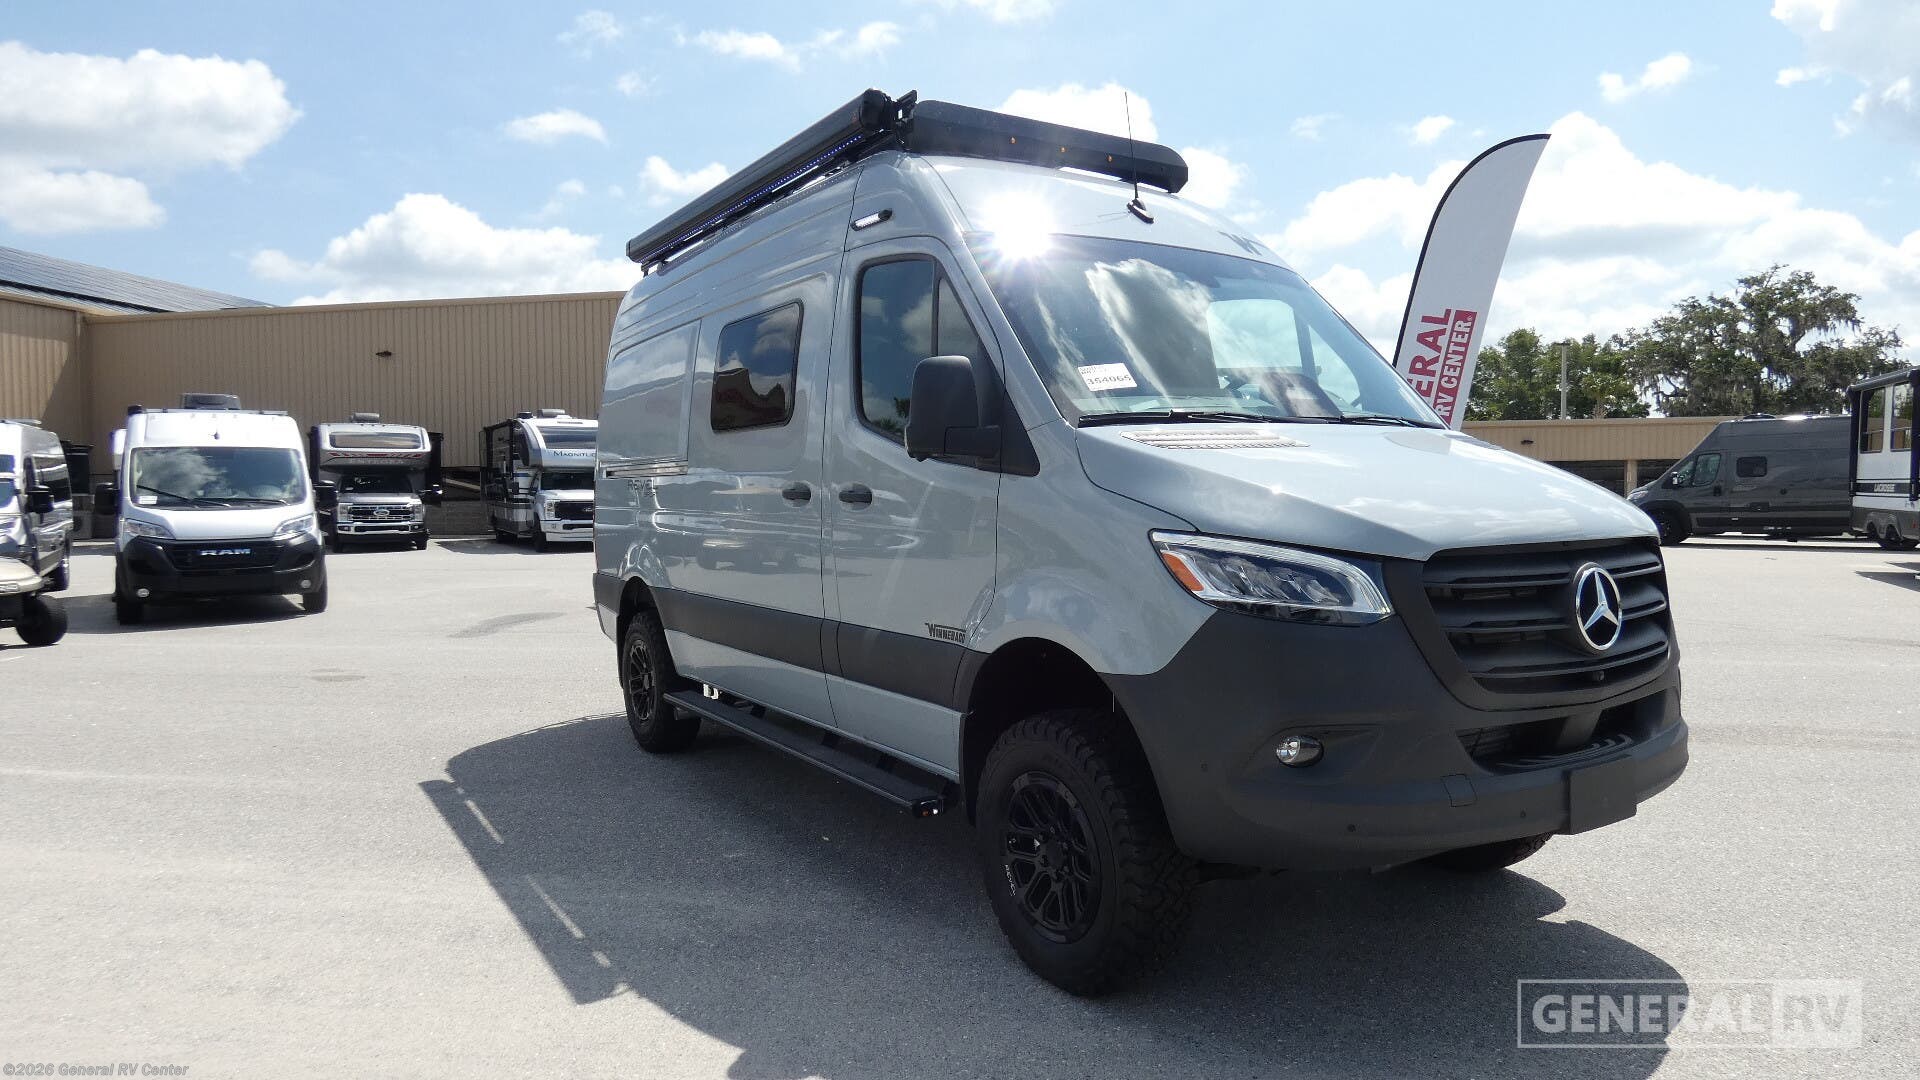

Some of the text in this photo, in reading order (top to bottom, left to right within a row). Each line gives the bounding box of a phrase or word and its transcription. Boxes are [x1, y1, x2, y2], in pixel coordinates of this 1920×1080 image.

[1407, 308, 1452, 398] ERAL
[1434, 319, 1473, 417] RV CENTER
[200, 548, 251, 556] RAM
